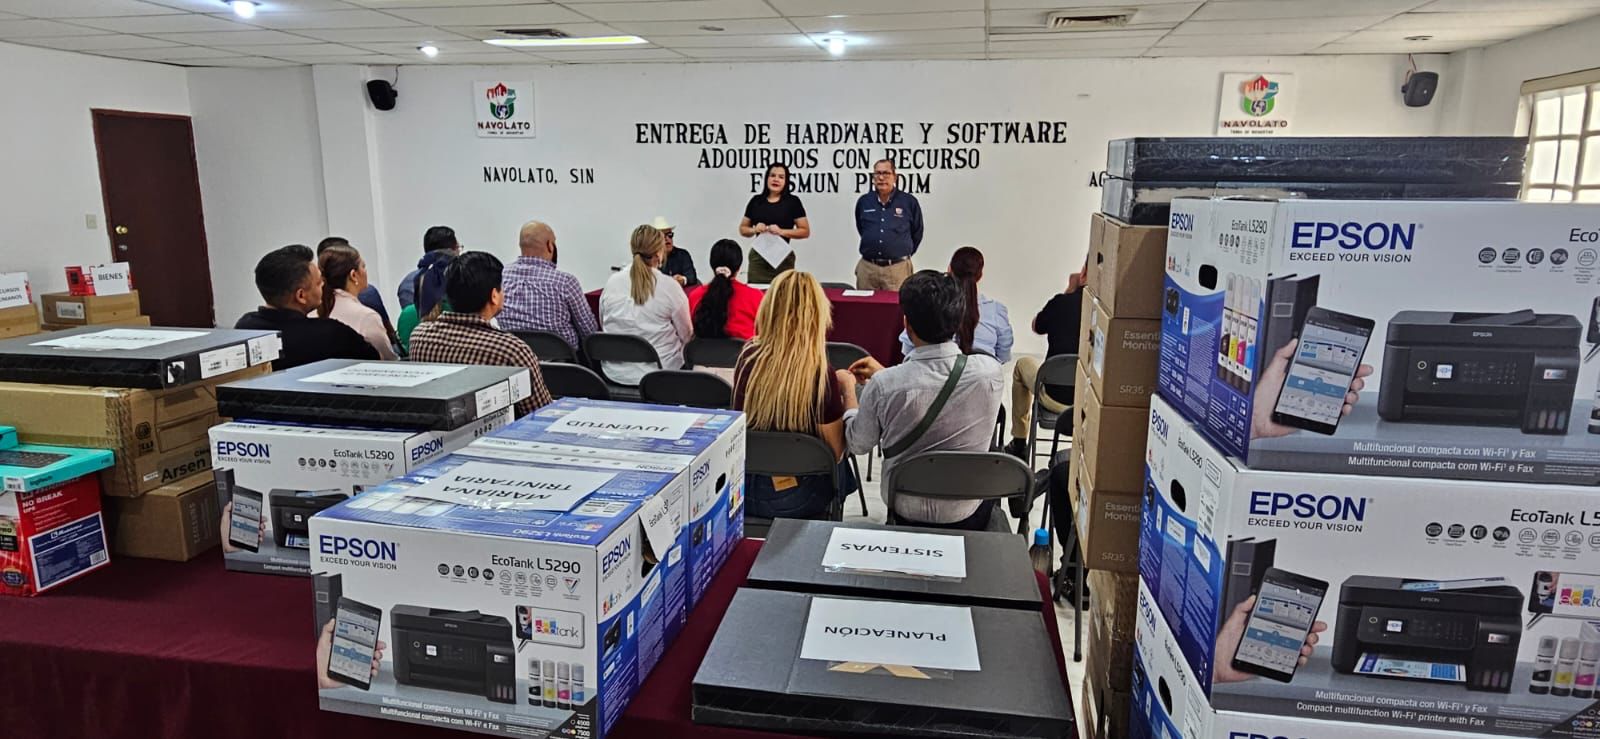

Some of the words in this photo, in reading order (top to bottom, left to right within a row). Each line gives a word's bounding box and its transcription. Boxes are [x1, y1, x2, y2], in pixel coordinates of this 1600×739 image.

[478, 122, 530, 130] NAVOLATO
[636, 123, 728, 144] ENTREGA
[744, 124, 770, 144] DE
[786, 123, 904, 144] HARDWARE
[920, 123, 934, 144] Y
[946, 122, 1068, 144] SOFTWARE
[1223, 120, 1288, 128] NAVOLATO
[698, 148, 818, 169] ADQUIRIDOS
[832, 148, 870, 169] CON
[886, 148, 980, 170] RECURSO
[483, 166, 558, 184] NAVOLATO,
[570, 168, 594, 184] SIN
[750, 172, 840, 193] FSMUN
[1171, 212, 1194, 232] EPSON
[1248, 219, 1268, 234] L5290
[1291, 222, 1416, 250] EPSON
[1570, 228, 1600, 242] Eco
[1290, 252, 1335, 261] EXCEED
[1338, 252, 1370, 262] YOUR
[1373, 254, 1412, 263] VISION
[98, 272, 123, 280] BIENES
[1122, 340, 1159, 350] Monito
[566, 420, 669, 432] JUVENTUD
[1152, 408, 1169, 440] EPSON
[217, 441, 270, 458] EPSON
[334, 449, 363, 458] EcoTank
[364, 450, 395, 460] L5290
[412, 437, 444, 462] EPSON
[1353, 441, 1416, 454] Multifuncional
[1417, 446, 1462, 458] compacta
[1464, 448, 1481, 457] con
[1512, 450, 1518, 460] y
[1519, 449, 1536, 458] Fax
[160, 458, 206, 483] Arsen
[692, 458, 711, 486] EPSON
[1348, 456, 1410, 468] Multifuncional
[1412, 460, 1456, 472] compacta
[1458, 462, 1478, 472] com
[1516, 464, 1534, 474] Fax
[454, 475, 572, 491] TRINITARIA
[22, 499, 34, 508] NO
[36, 490, 63, 504] BREAK
[442, 485, 552, 500] MARIANA
[1250, 490, 1366, 522] EPSON
[1104, 511, 1140, 521] Monito
[1510, 508, 1575, 526] EcoTank
[1580, 510, 1600, 526] L5
[1248, 518, 1290, 528] EXCEED
[1294, 520, 1323, 530] YOUR
[1326, 522, 1363, 533] VISION
[320, 534, 396, 561] EPSON
[602, 533, 632, 575] EPSON
[841, 542, 944, 558] SISTEMAS
[320, 556, 350, 566] EXCEED
[350, 560, 370, 568] YOUR
[372, 562, 398, 570] VISION
[491, 554, 534, 569] EcoTank
[537, 558, 581, 574] L5290
[824, 625, 946, 642] PLANEACIÓN
[382, 696, 422, 710] Multifuncional
[424, 702, 452, 714] compacta
[452, 706, 464, 714] con
[488, 710, 500, 720] Fax
[1315, 690, 1374, 704] Multifuncional
[1376, 696, 1418, 708] compacta
[1418, 700, 1435, 708] con
[1464, 705, 1471, 714] y
[1472, 704, 1488, 714] Fax
[380, 706, 421, 720] Multifuncional
[421, 713, 450, 726] compacta
[450, 717, 464, 726] com
[488, 722, 500, 730] Fax
[1296, 702, 1333, 714] Compact
[1335, 706, 1390, 718] multifunction
[1418, 712, 1448, 724] printer
[1449, 715, 1468, 726] with
[1470, 717, 1486, 726] Fax
